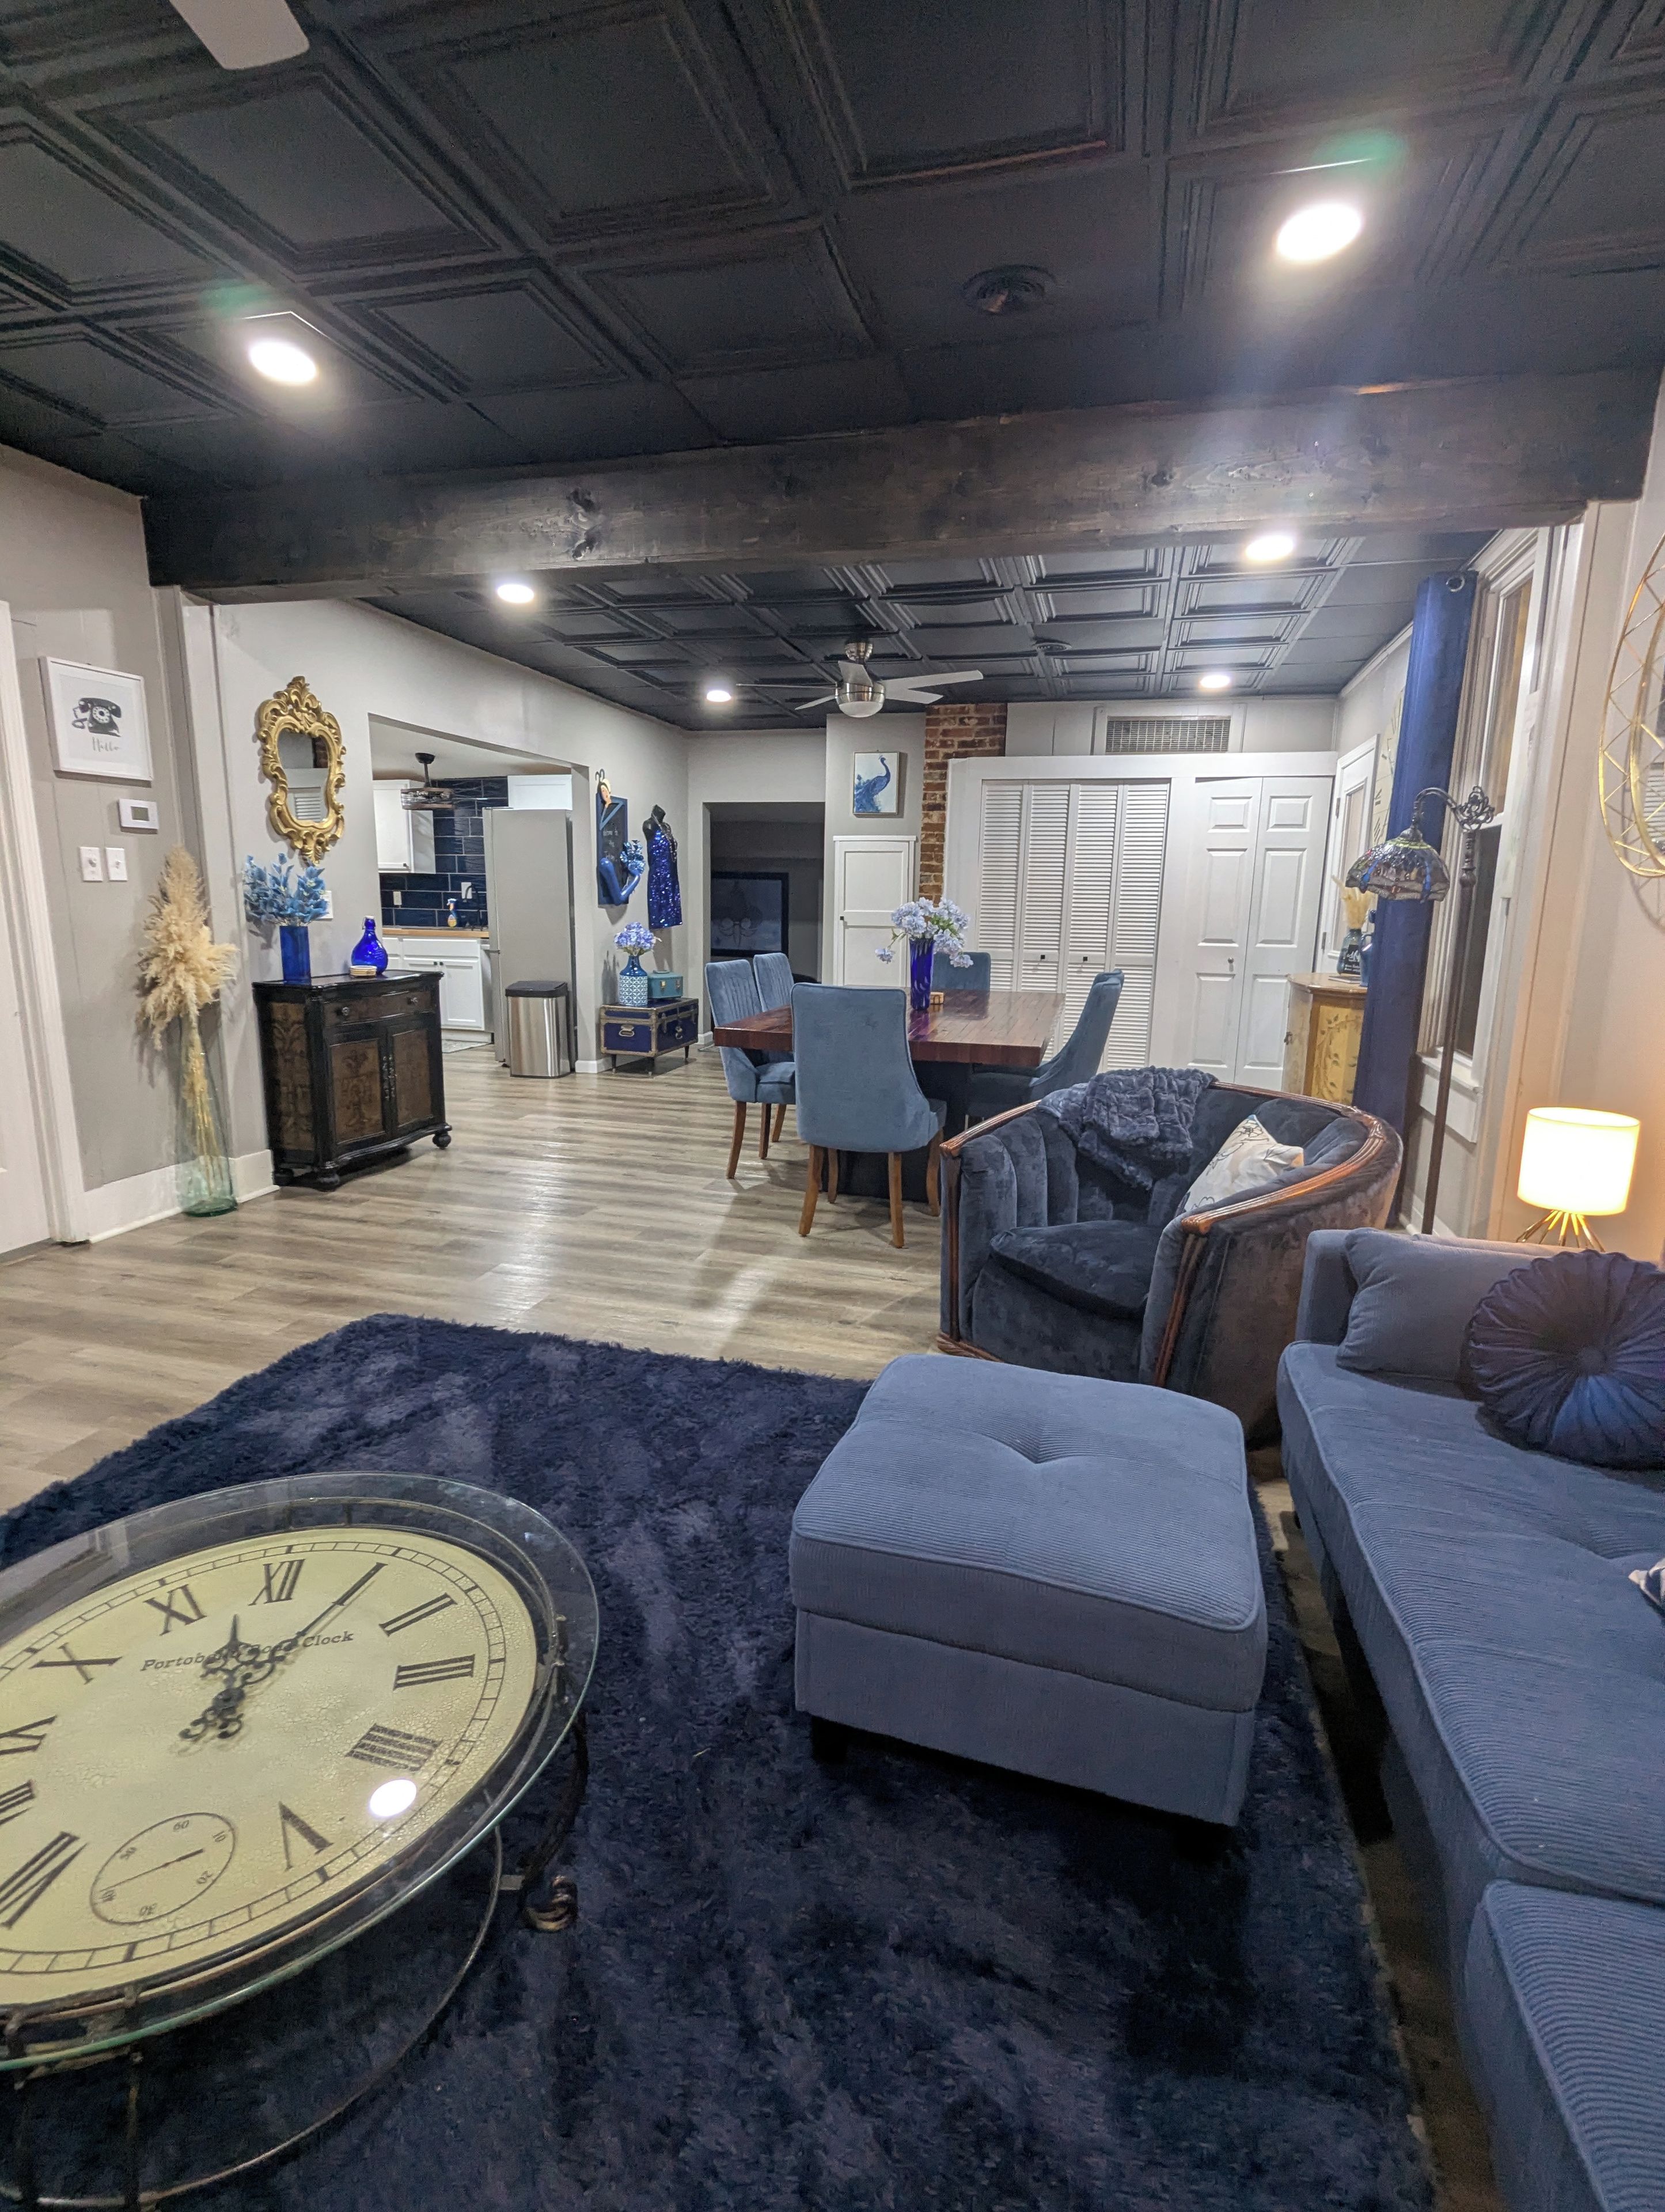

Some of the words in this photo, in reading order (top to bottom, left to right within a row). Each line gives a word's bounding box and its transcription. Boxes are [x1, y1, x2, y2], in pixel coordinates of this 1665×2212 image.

[248, 1559, 306, 1607] XII
[143, 1584, 207, 1636] XI
[29, 1642, 123, 1685] X
[140, 1642, 241, 1672] Portob
[302, 1630, 354, 1647] Clock
[173, 1819, 190, 1832] 60
[279, 1801, 334, 1872] V
[196, 1870, 213, 1885] 20
[139, 1903, 158, 1916] 30
